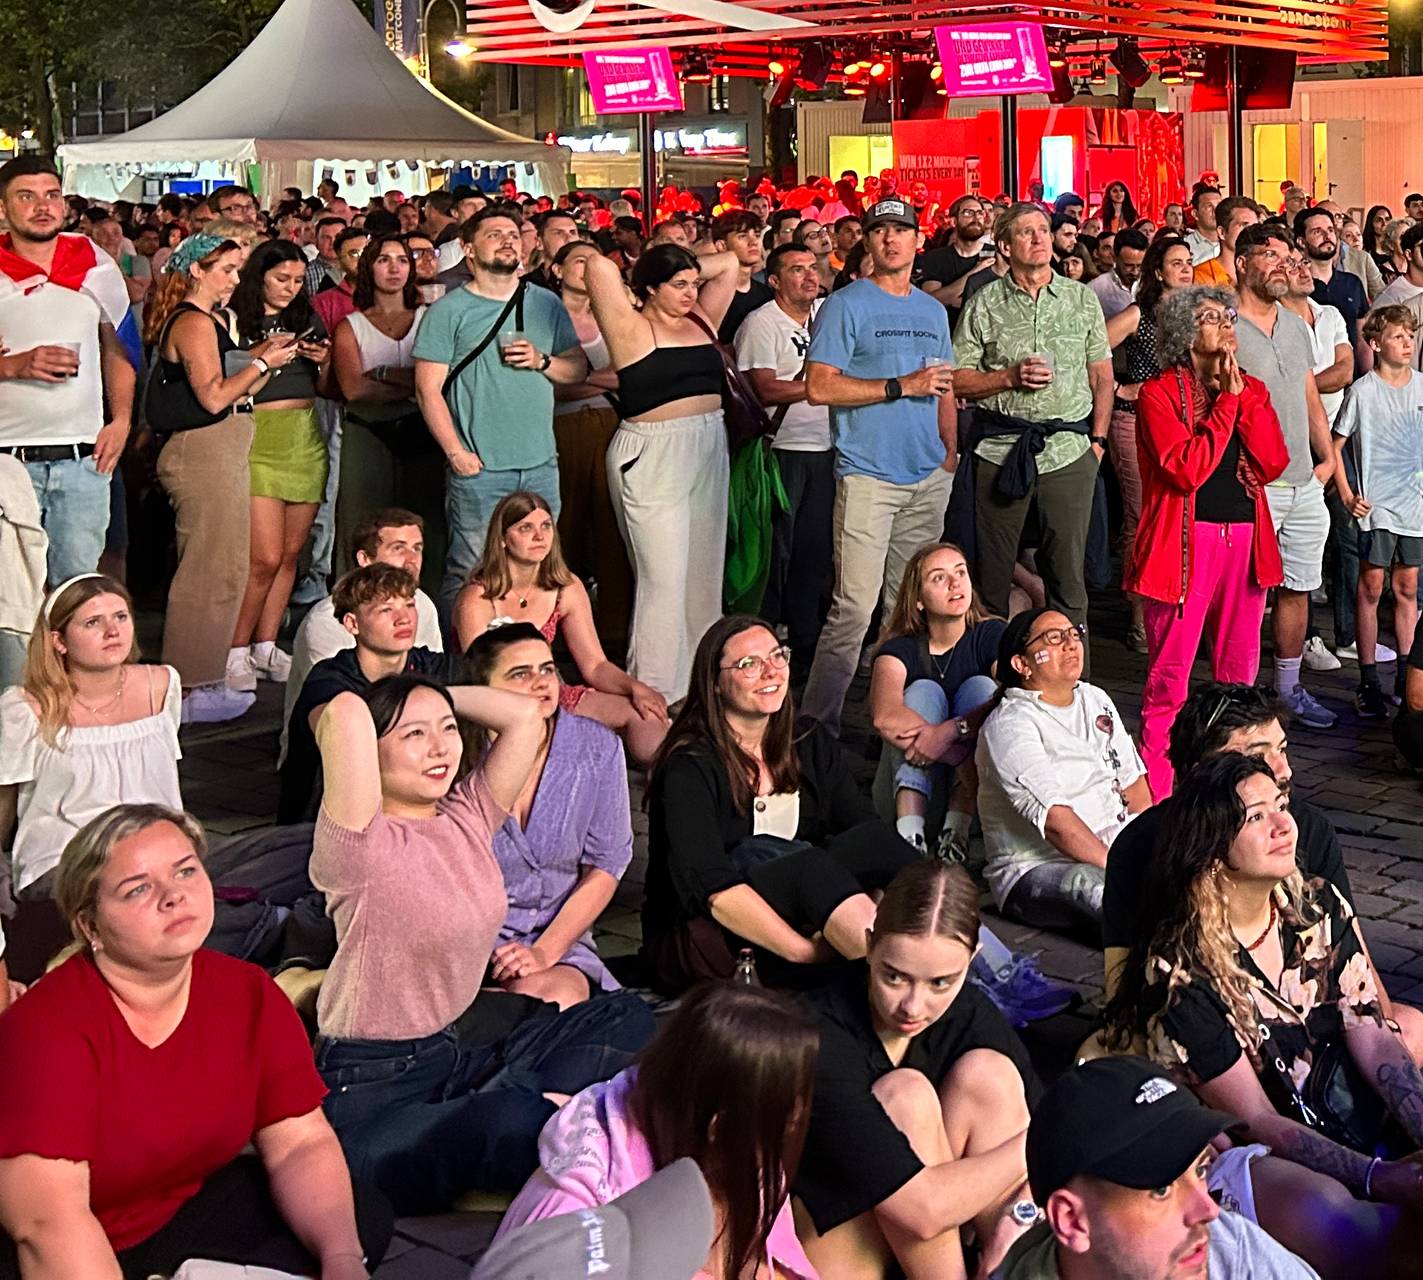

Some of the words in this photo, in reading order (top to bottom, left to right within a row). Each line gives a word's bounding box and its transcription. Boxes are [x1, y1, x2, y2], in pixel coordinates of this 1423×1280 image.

[900, 155, 916, 168] WIN
[918, 155, 932, 168] 1X2
[900, 168, 932, 181] TICKETS
[932, 168, 952, 180] EVERY
